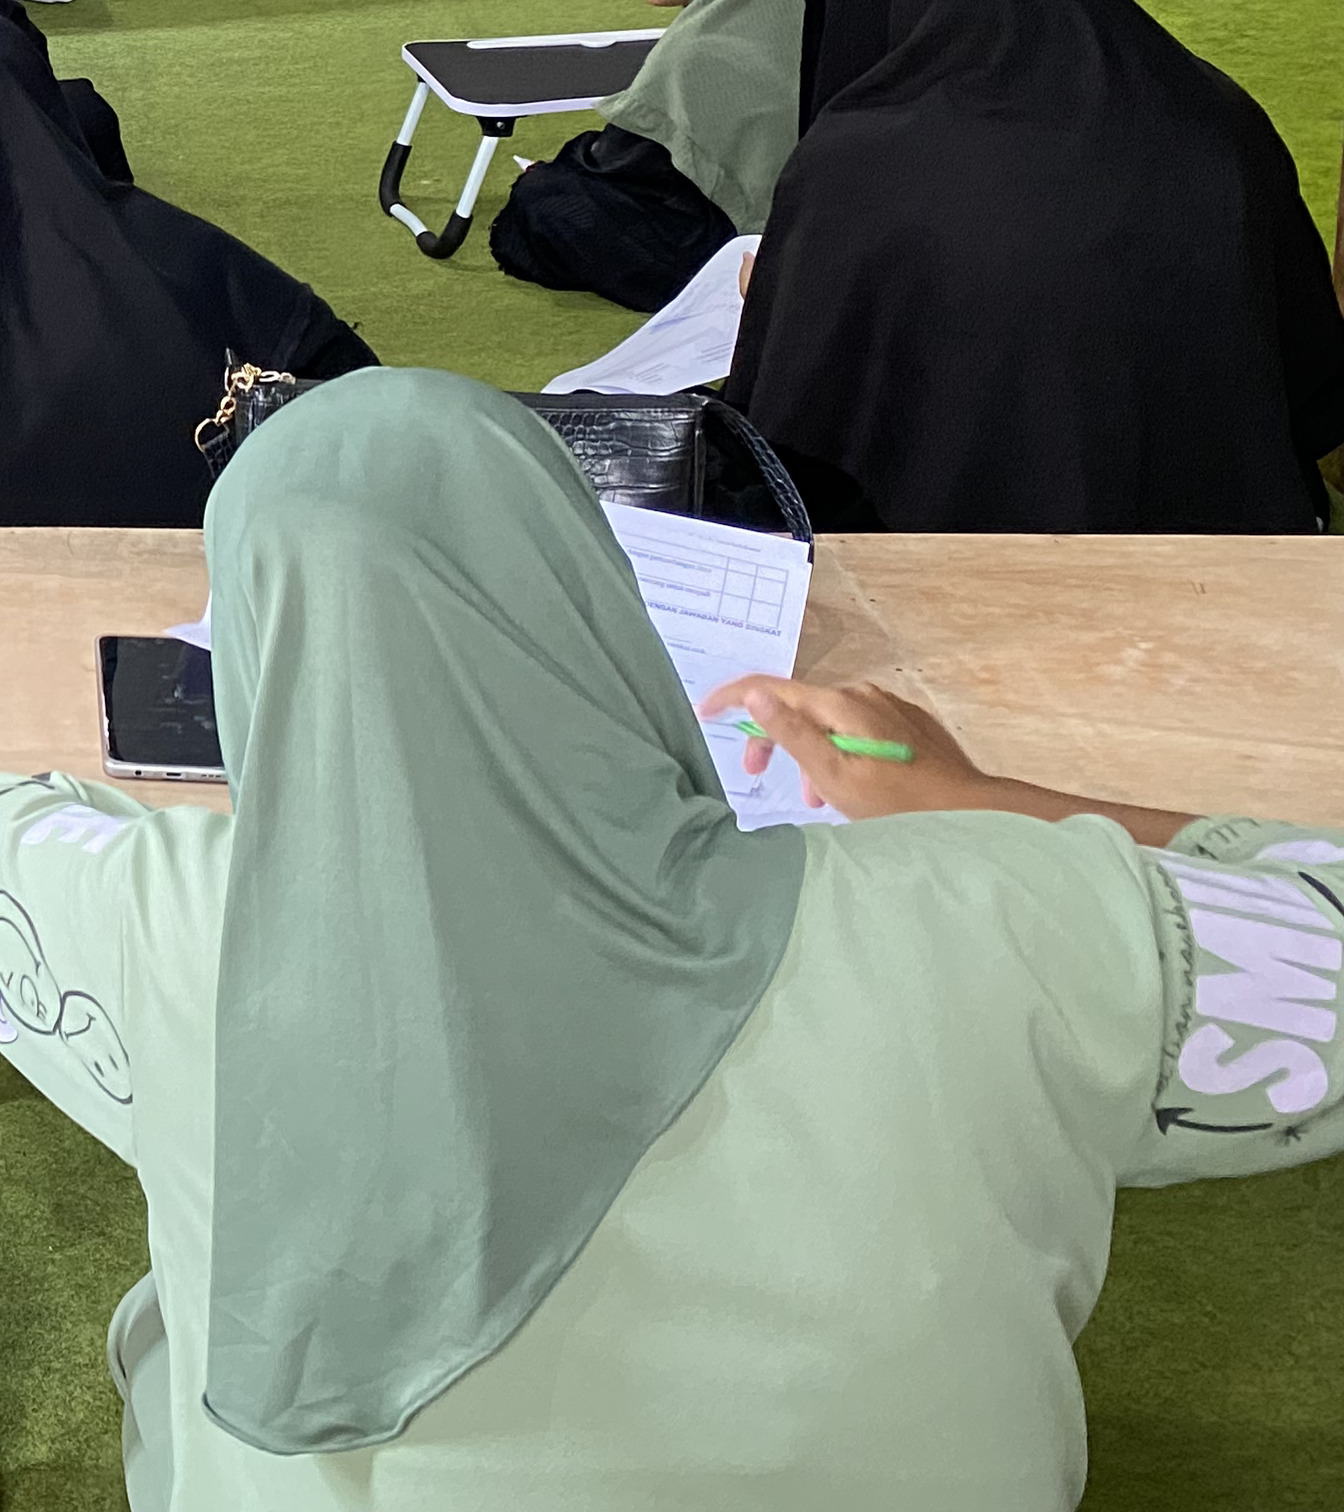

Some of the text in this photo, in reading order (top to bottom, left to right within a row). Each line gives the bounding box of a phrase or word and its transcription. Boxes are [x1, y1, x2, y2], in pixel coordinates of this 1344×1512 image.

[678, 607, 719, 623] JAWABAN
[721, 616, 744, 628] YANG
[745, 623, 782, 637] SINGKAT
